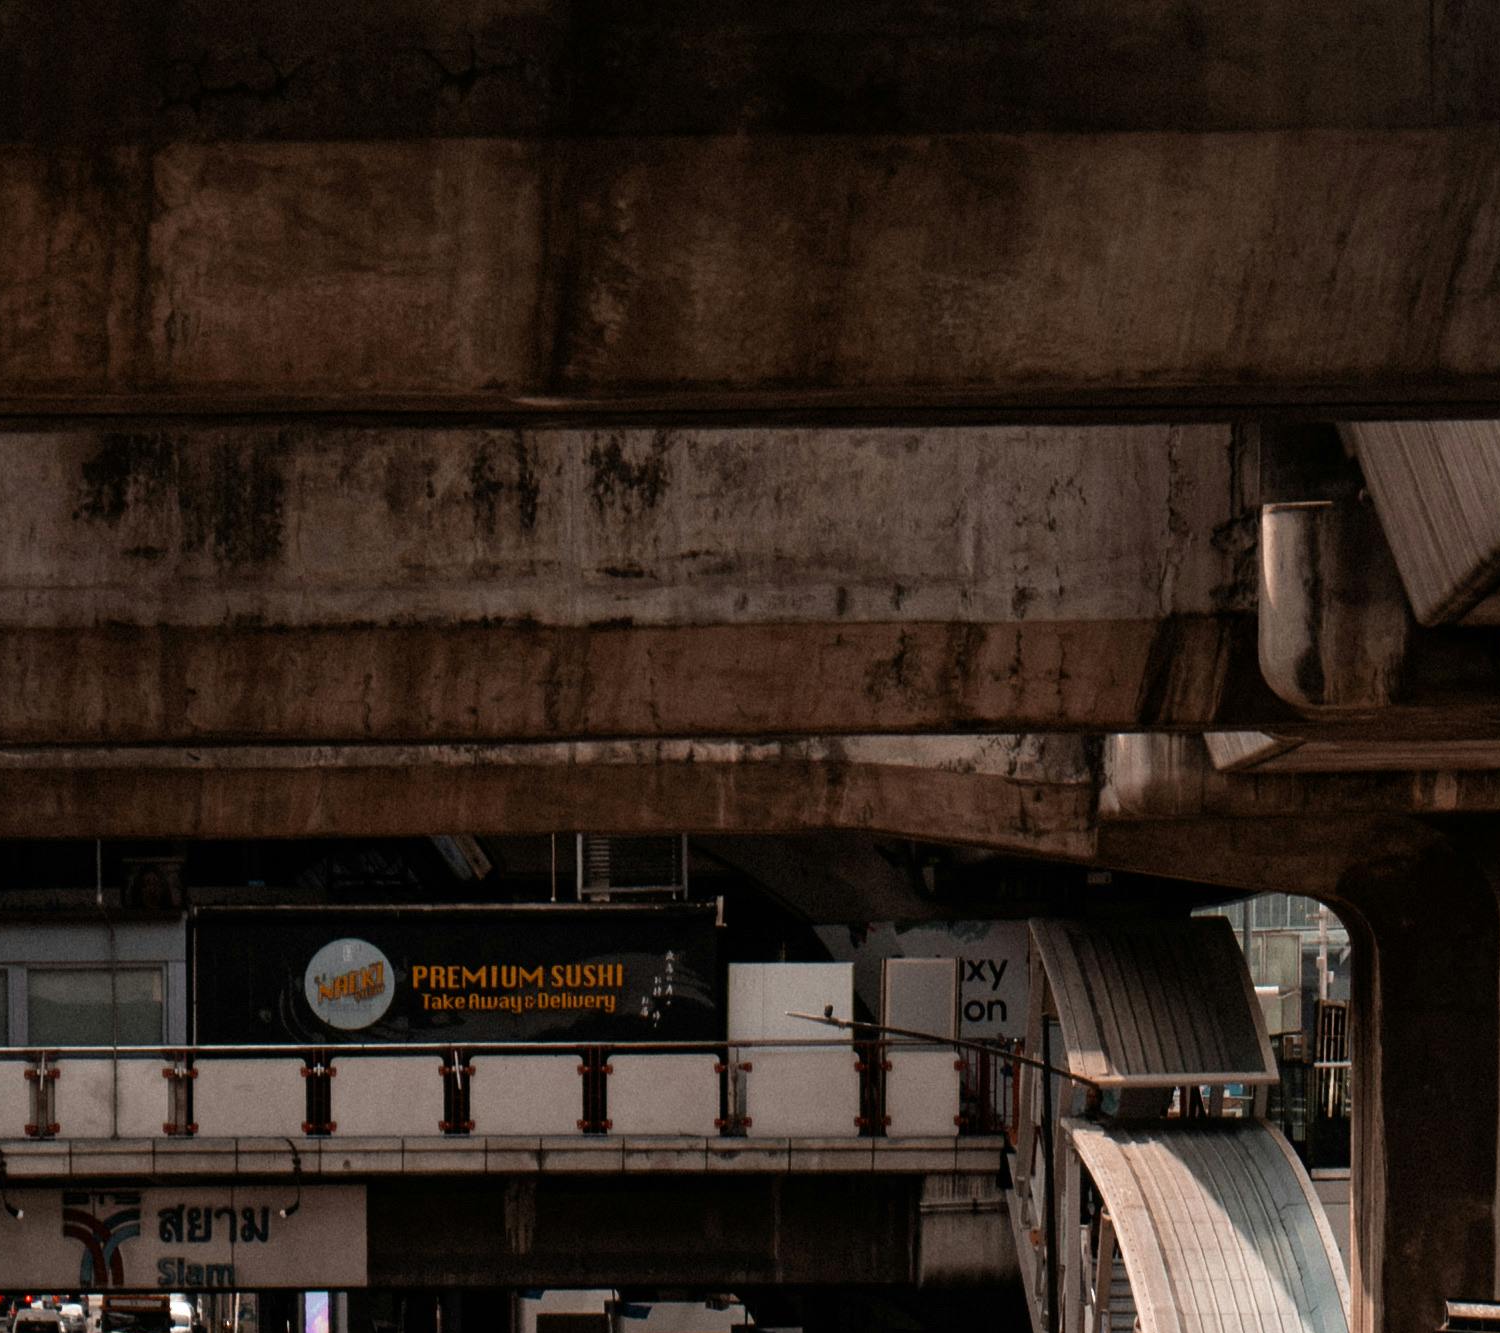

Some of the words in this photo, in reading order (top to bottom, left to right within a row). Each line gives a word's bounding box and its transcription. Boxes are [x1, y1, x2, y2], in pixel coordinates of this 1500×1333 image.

[412, 965, 544, 990] PREMIUM
[551, 964, 623, 989] SUSHI
[421, 993, 464, 1012] Take
[467, 992, 523, 1014] Away
[536, 992, 617, 1014] Delivery
[157, 1203, 270, 1243] สยาม
[156, 1257, 235, 1287] Siam
